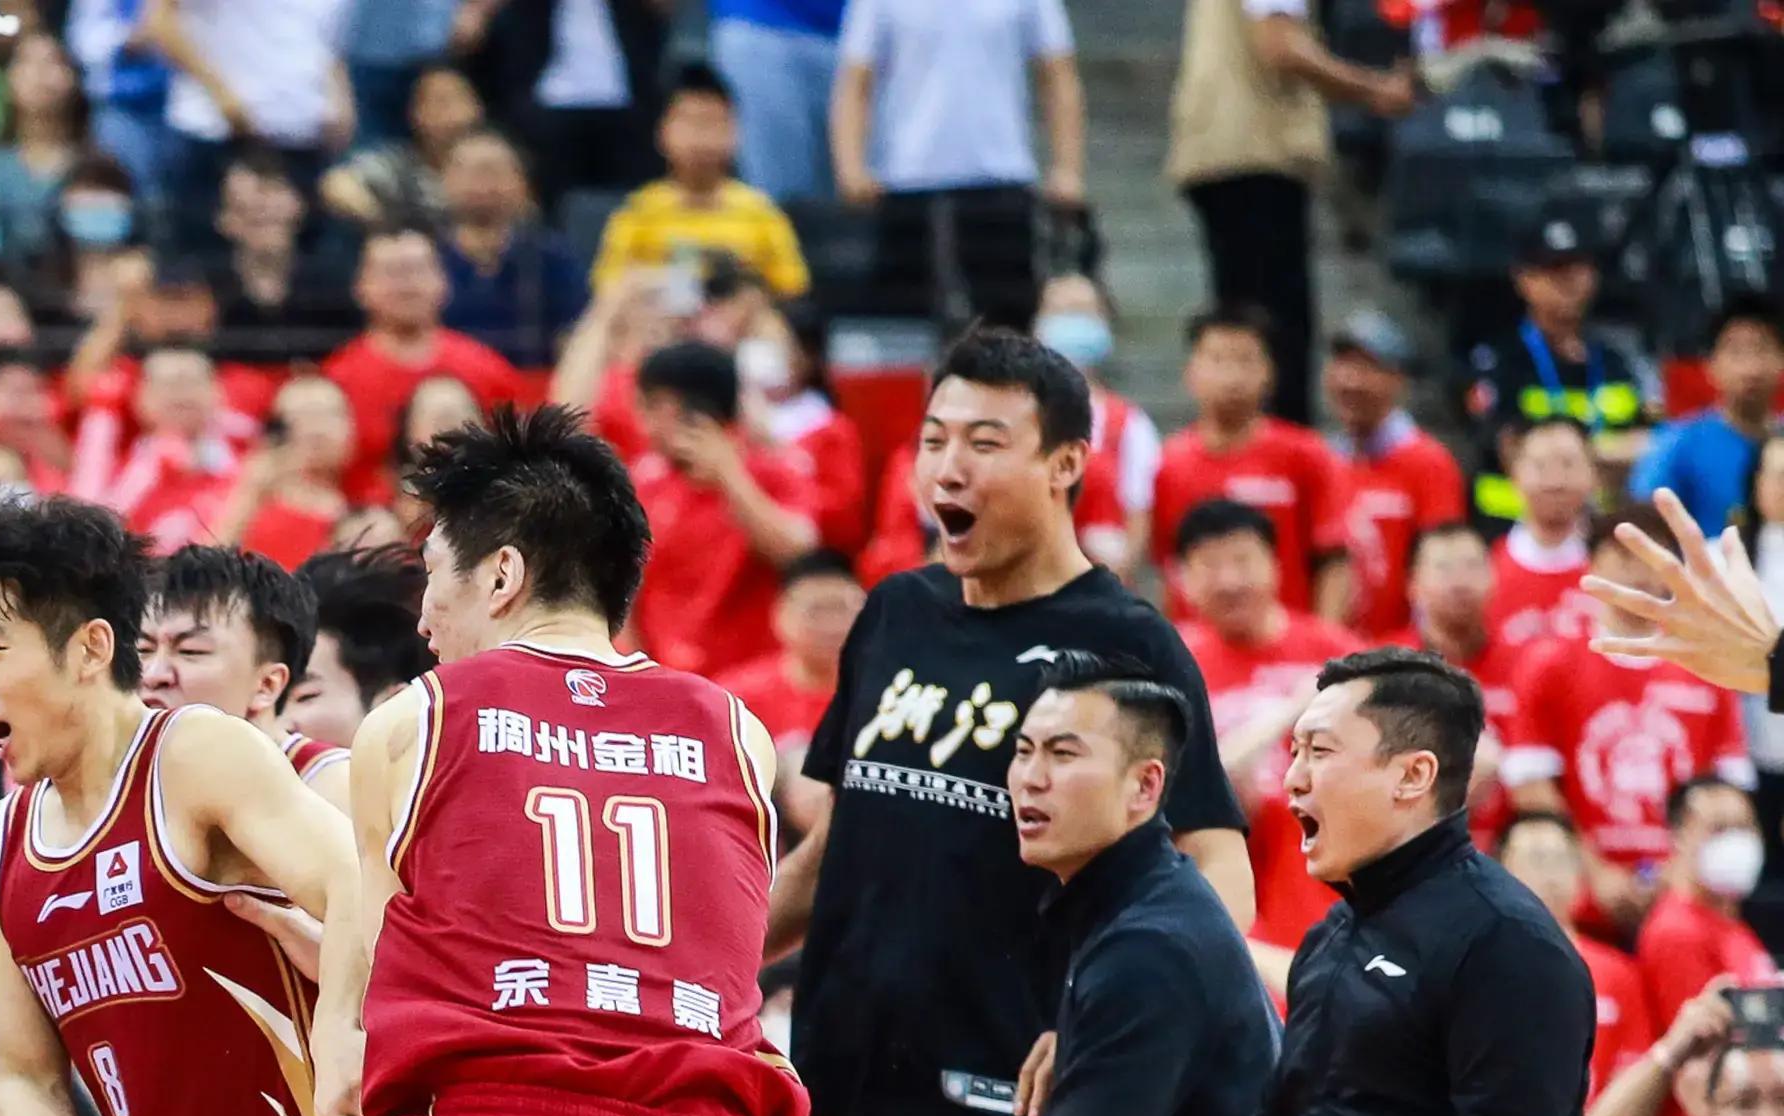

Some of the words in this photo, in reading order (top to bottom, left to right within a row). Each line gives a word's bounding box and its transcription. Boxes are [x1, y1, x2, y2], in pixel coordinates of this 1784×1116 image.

[476, 706, 707, 784] 稠州金租
[523, 785, 673, 948] 11
[20, 922, 179, 1020] HEJIANG
[490, 957, 723, 1041] 余嘉豪
